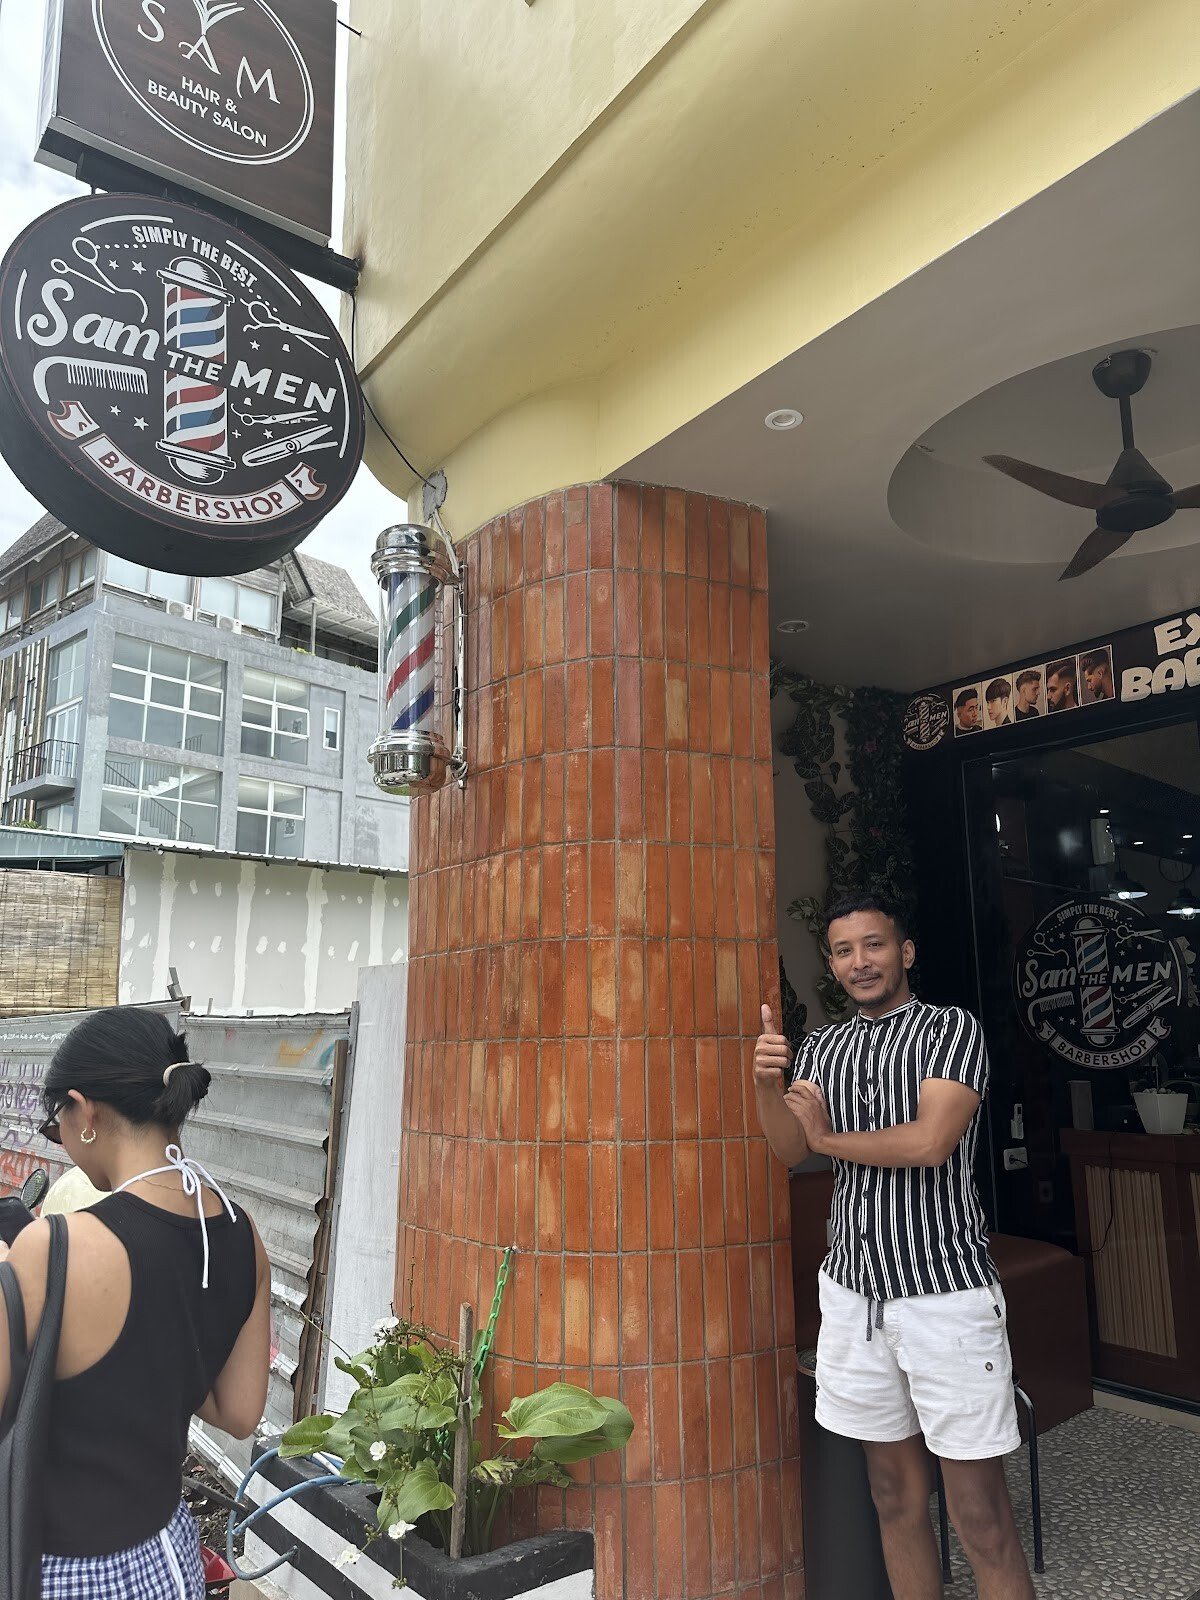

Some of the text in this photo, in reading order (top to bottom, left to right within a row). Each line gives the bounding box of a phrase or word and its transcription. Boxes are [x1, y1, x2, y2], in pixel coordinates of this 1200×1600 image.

[148, 79, 267, 147] BEAUTY SALON
[181, 75, 238, 115] HAIR &
[131, 225, 257, 287] SIMPLY THE BEST
[26, 278, 337, 413] Sam THE MEN
[98, 450, 284, 519] BARBERSHOP
[1056, 903, 1119, 922] SIMPLY THE BEST
[1022, 959, 1172, 998] Sam THE MEN
[1057, 1038, 1148, 1066] BARBERSHOP
